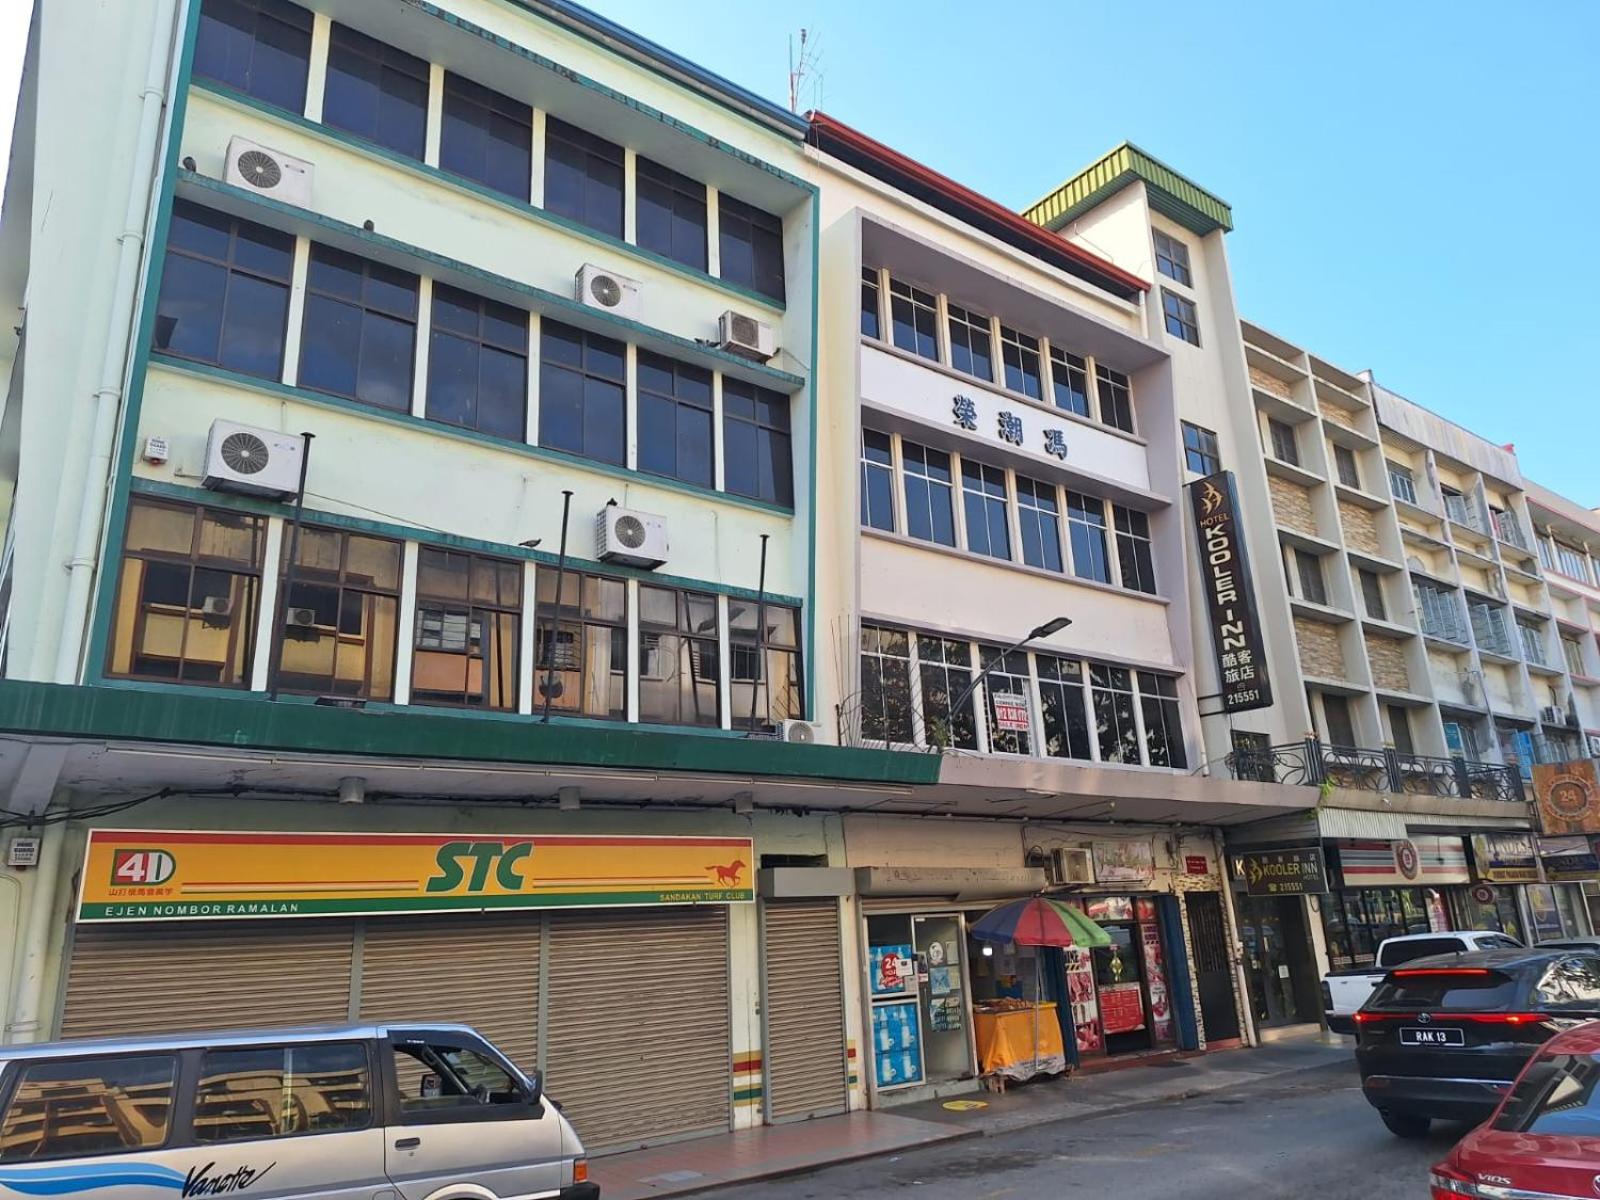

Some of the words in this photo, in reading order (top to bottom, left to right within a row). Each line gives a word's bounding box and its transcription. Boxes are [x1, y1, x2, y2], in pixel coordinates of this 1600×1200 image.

[1200, 513, 1229, 529] HOTEL
[1205, 522, 1237, 606] KOOLER
[1221, 608, 1246, 651] INN
[1227, 688, 1260, 706] 215551
[112, 849, 177, 886] 4D
[425, 841, 536, 893] STC
[1263, 862, 1300, 877] KOOLER
[1301, 861, 1318, 874] INN
[659, 893, 700, 902] SANDAKAN
[704, 892, 721, 900] TURF
[726, 891, 745, 900] CLUB
[105, 906, 147, 916] EJEN
[153, 904, 221, 916] NOMBOR
[226, 903, 299, 914] RAMALAN
[1415, 1031, 1435, 1043] RAK
[1437, 1032, 1447, 1043] 13
[1477, 1172, 1512, 1186] VIOS
